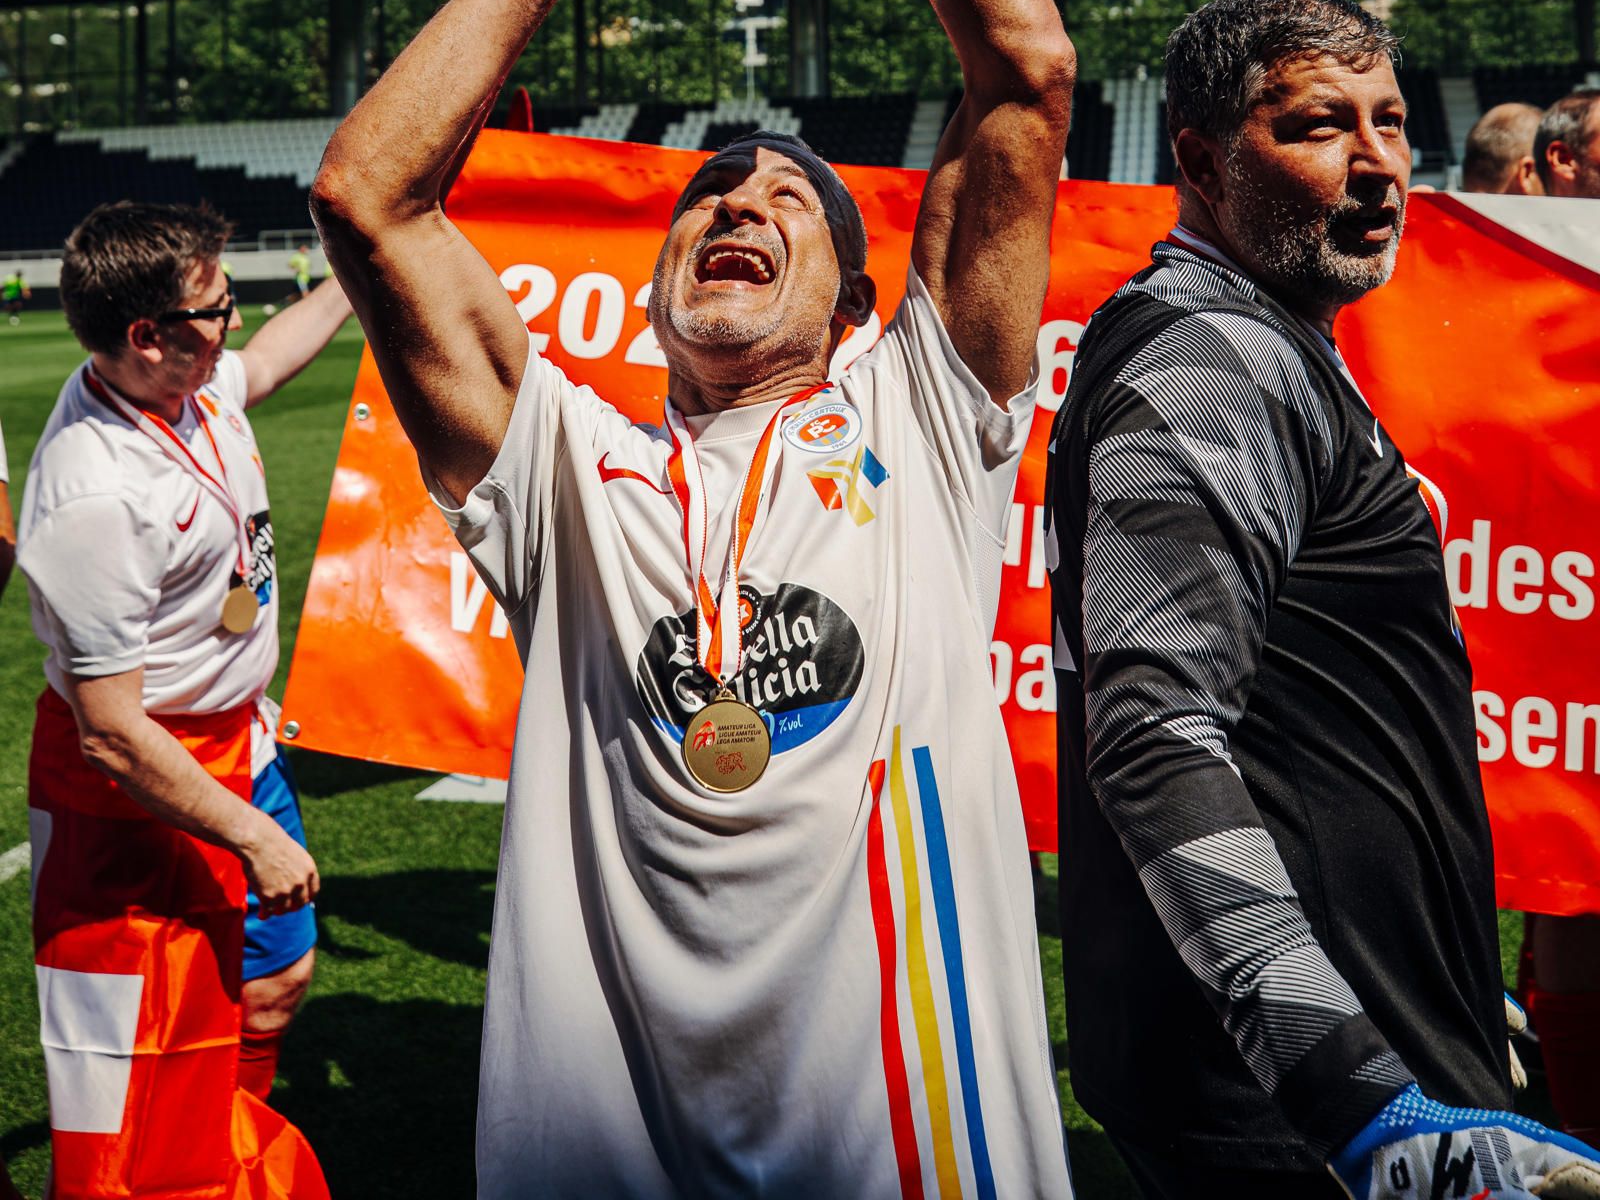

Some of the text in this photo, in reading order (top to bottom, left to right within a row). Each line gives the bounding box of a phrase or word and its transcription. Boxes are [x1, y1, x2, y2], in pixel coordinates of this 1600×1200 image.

[1443, 519, 1595, 621] des
[673, 658, 821, 713] Glicia
[730, 736, 756, 745] AMATORI
[735, 729, 762, 738] AMATEUR
